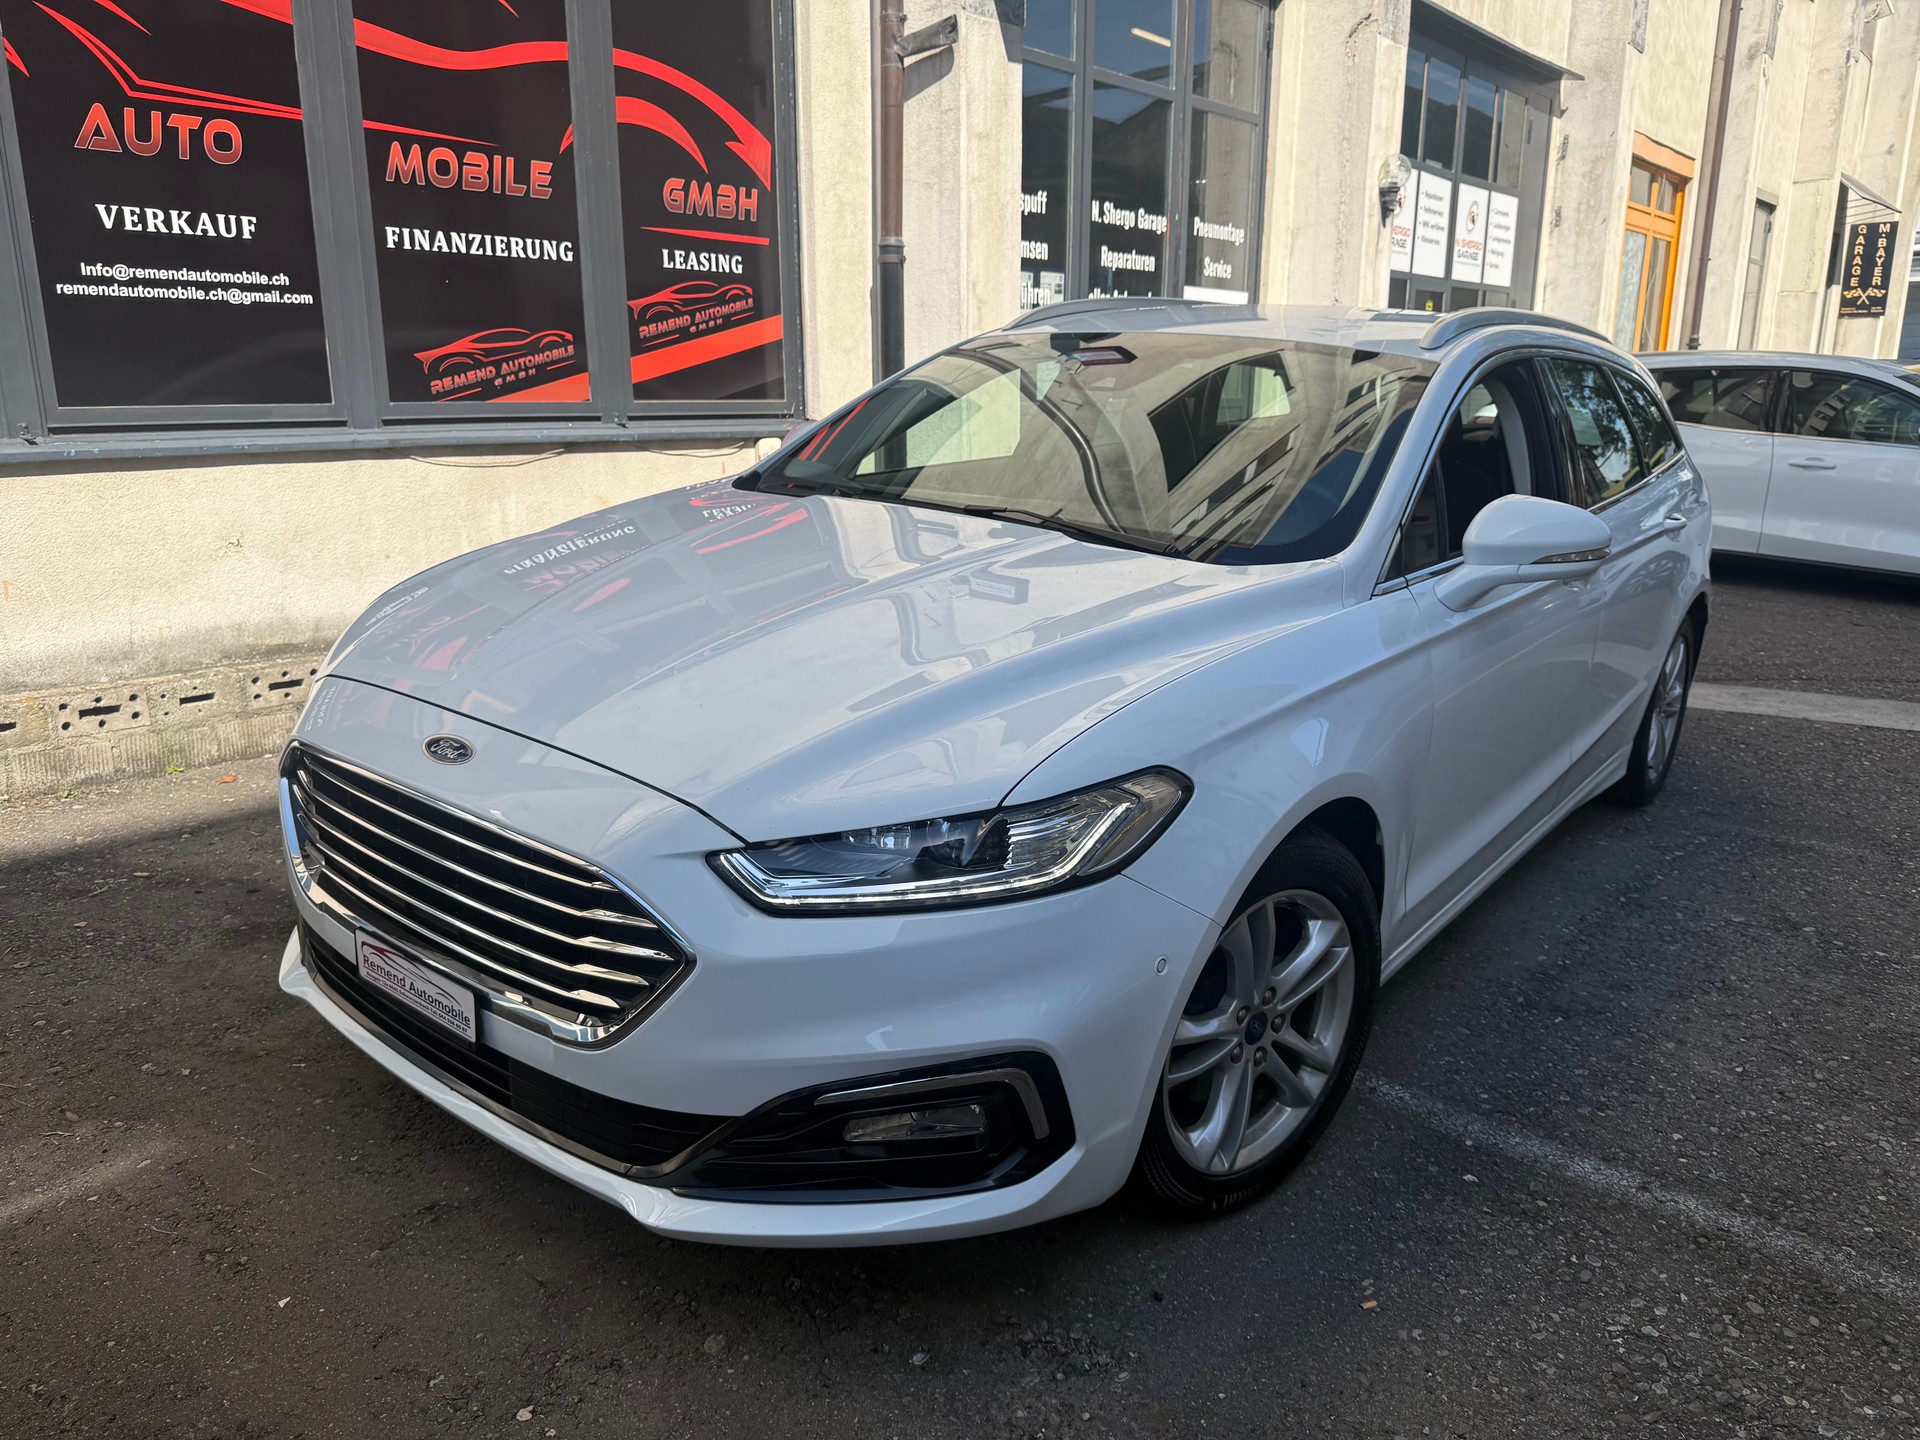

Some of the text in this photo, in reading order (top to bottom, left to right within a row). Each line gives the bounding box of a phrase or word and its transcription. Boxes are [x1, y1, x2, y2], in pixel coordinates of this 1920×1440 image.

[74, 102, 758, 222] AUTO MOBILE GMBH
[95, 203, 257, 239] VERKAUF
[1091, 199, 1167, 235] N. Shergo Garage
[1193, 216, 1245, 246] Pneumontage
[384, 226, 574, 262] FINANZIERUNG
[662, 248, 743, 274] LEASING
[1101, 245, 1155, 272] Reparaturen
[1850, 224, 1867, 286] GARAGE
[80, 262, 290, 286] Info@remendautomobile.ch
[1203, 256, 1232, 279] Service
[56, 282, 314, 305] remendautomobile.ch@gmail.com
[639, 298, 754, 339] REMEND AUTOMOBILE
[430, 345, 575, 395] REMEND AUTOMOBILE
[363, 955, 471, 1026] Remend Automobile
